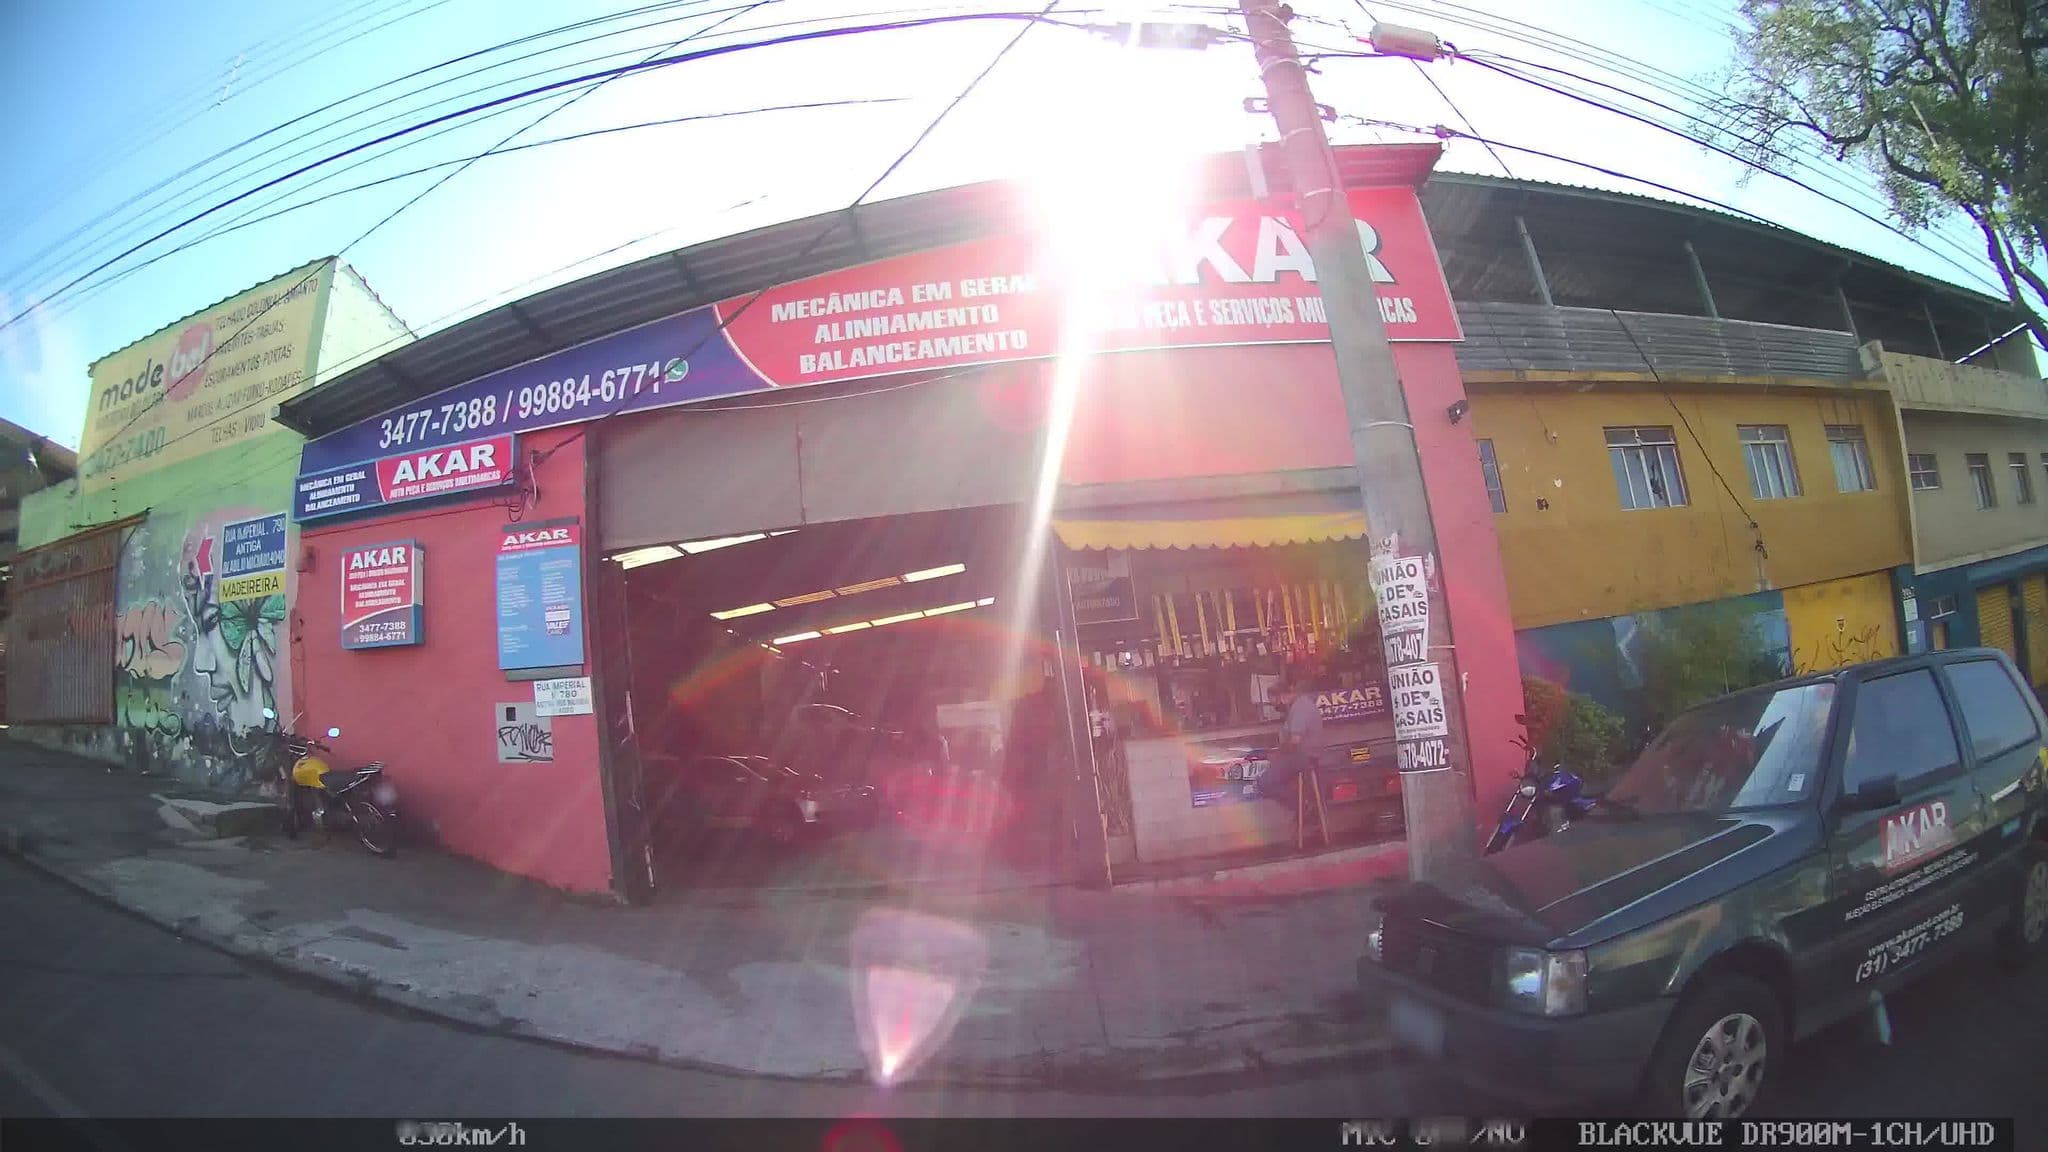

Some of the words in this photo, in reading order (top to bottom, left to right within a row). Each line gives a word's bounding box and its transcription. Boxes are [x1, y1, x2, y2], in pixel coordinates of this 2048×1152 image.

[770, 286, 905, 323] MECÂNICA
[912, 280, 952, 304] EM
[1211, 297, 1294, 328] SERVIÇOS
[813, 303, 999, 344] ALINHAMENTO
[799, 329, 1029, 375] BALANCEAMENTO
[379, 394, 497, 449] 3477-7388
[518, 360, 661, 419] 99884-6771
[392, 443, 496, 486] AKAR
[332, 474, 345, 486] EM
[305, 494, 361, 513] BALANCEAMENTO
[502, 528, 570, 546] AKAR
[349, 546, 406, 571] AKAR
[222, 576, 280, 598] MADEIREIRA
[1386, 584, 1406, 601] DE
[1391, 669, 1434, 690] UNIÃO
[559, 690, 577, 698] 780
[1316, 686, 1382, 708] AKAR
[1402, 691, 1422, 708] DE
[1396, 708, 1444, 729] CASAIS
[1886, 801, 1947, 861] AKAR
[1856, 951, 1888, 983] (31)
